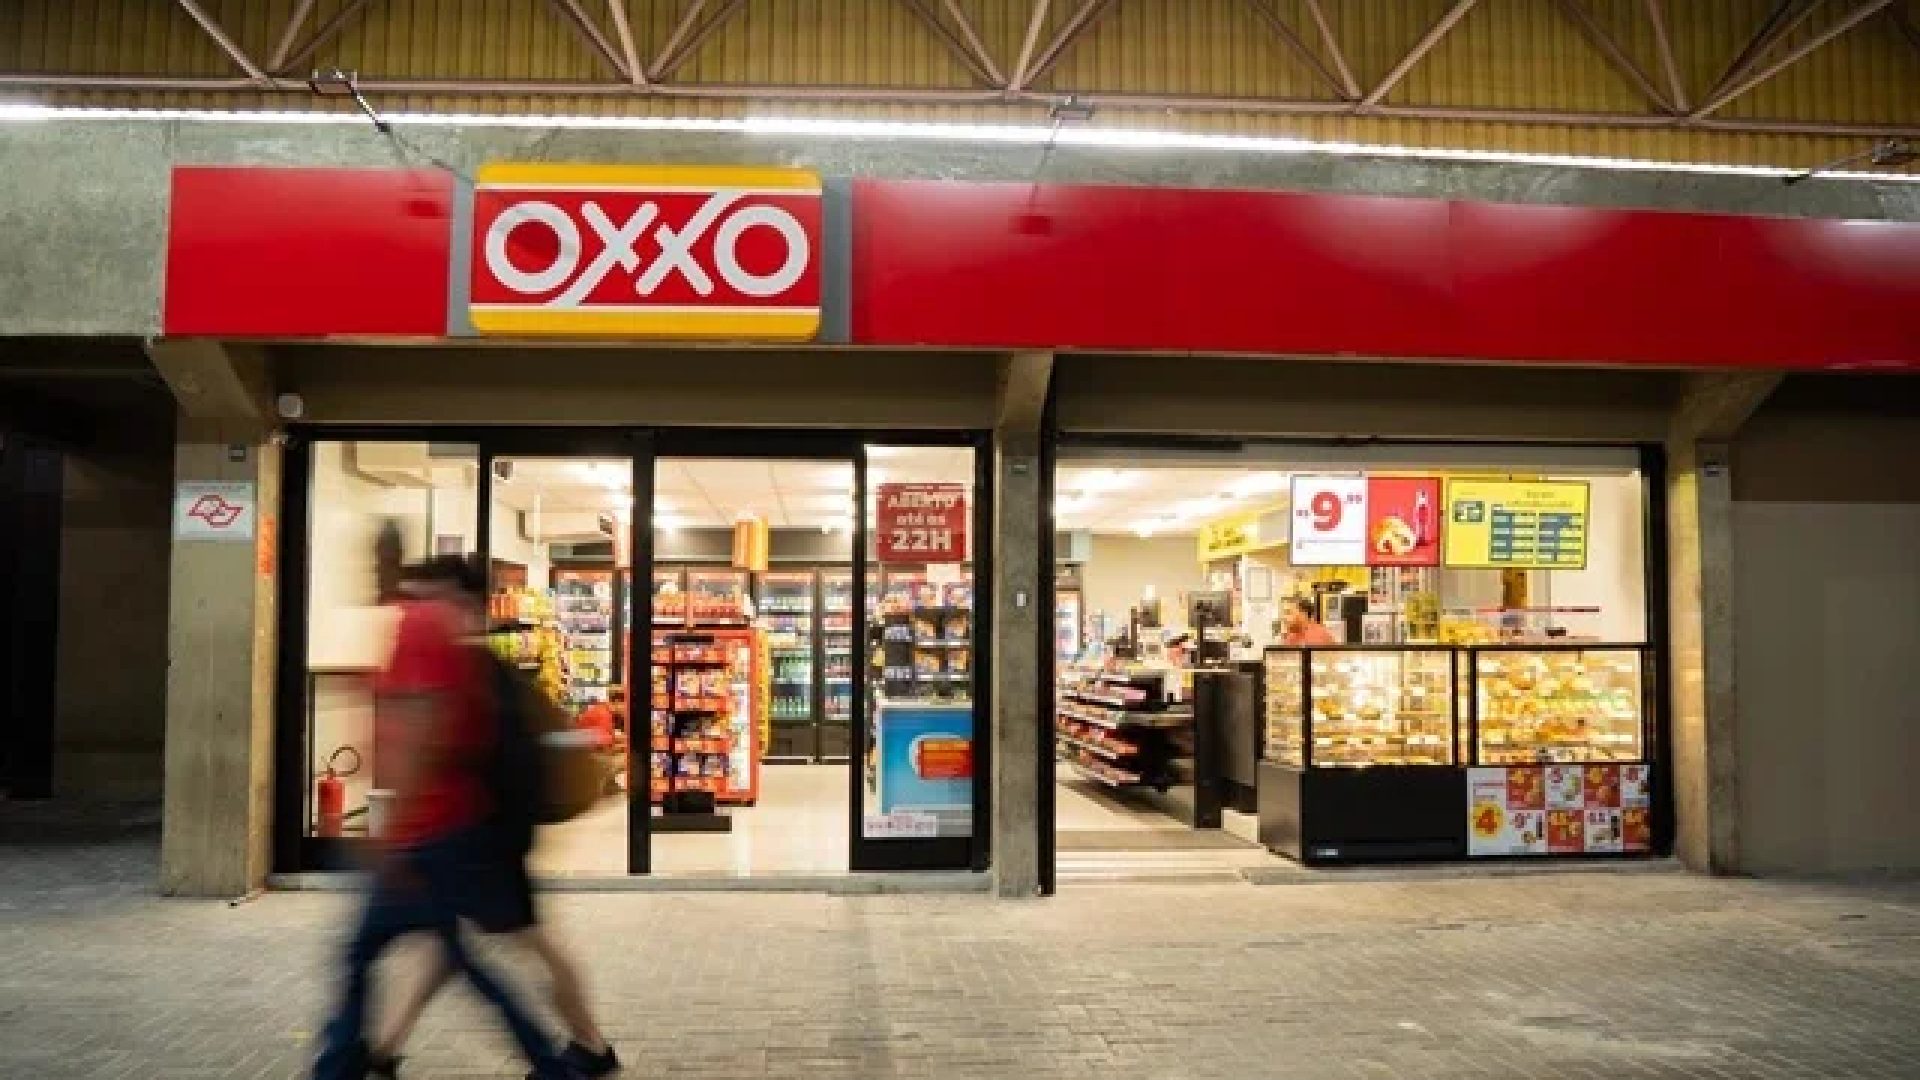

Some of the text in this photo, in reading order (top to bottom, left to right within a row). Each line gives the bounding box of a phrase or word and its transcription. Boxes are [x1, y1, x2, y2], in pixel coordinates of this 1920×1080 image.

[484, 191, 810, 307] OXXO
[1311, 491, 1342, 532] 9
[890, 528, 952, 551] 22H
[1475, 807, 1498, 834] 4
